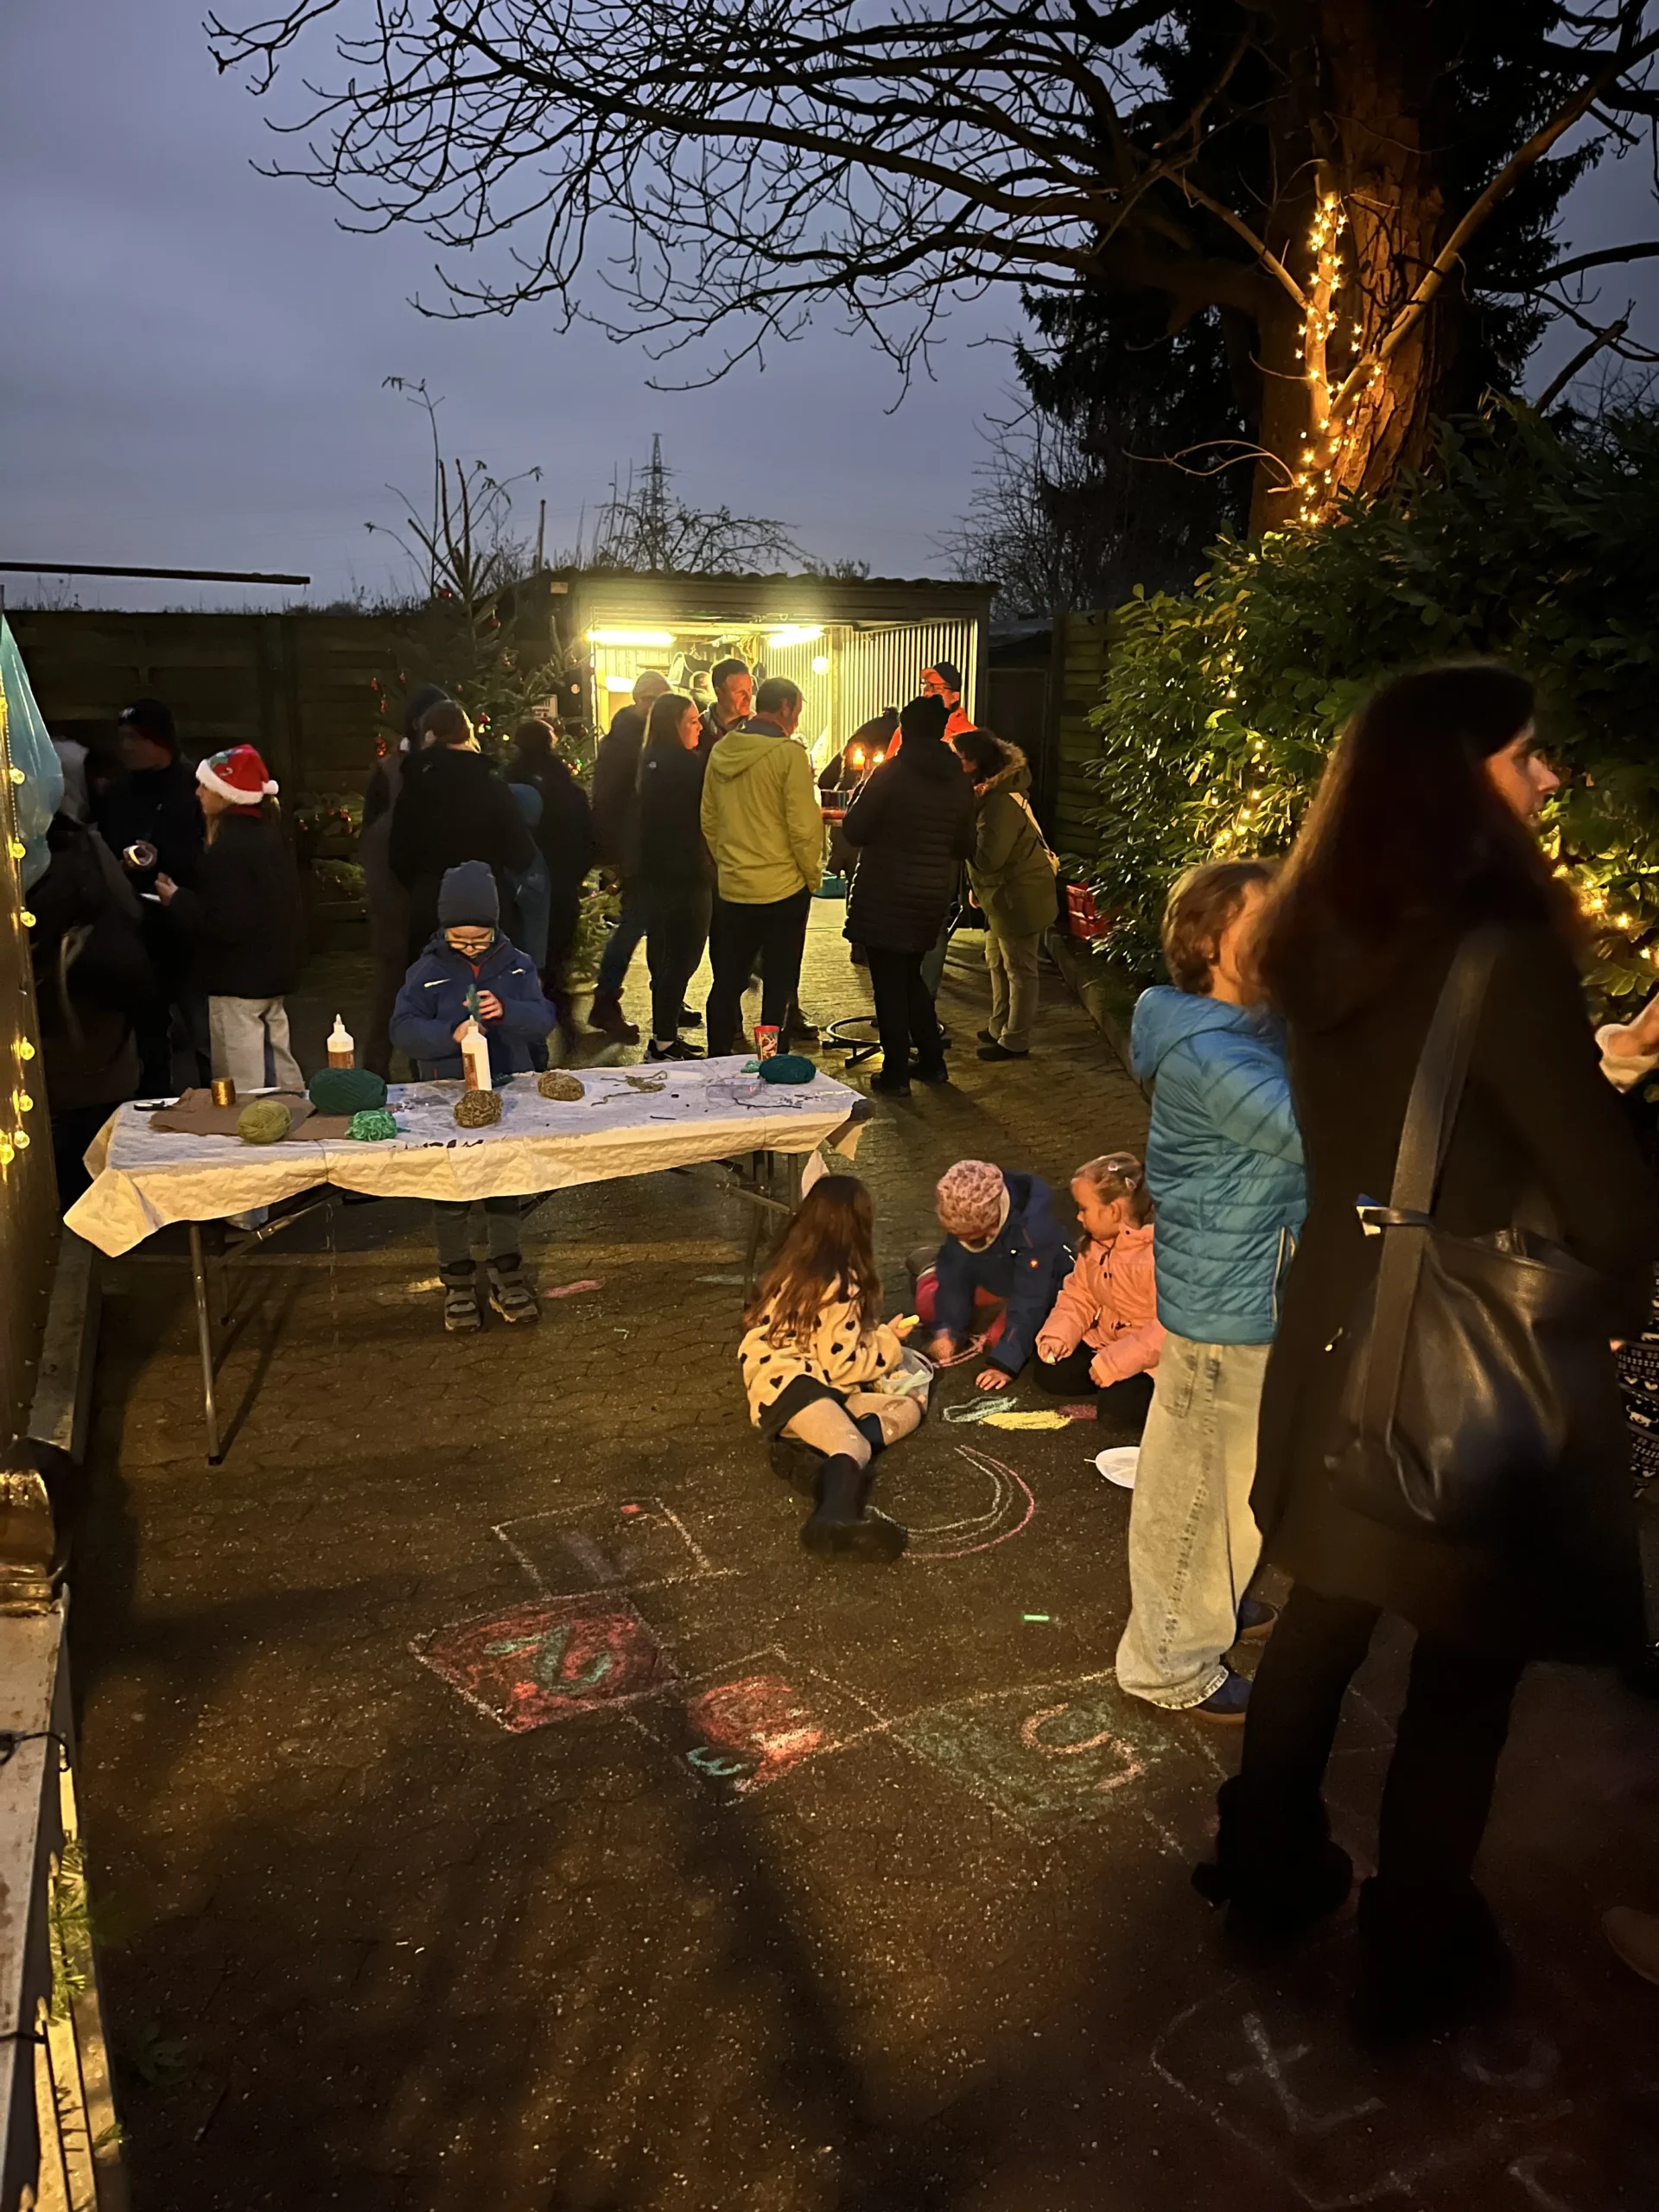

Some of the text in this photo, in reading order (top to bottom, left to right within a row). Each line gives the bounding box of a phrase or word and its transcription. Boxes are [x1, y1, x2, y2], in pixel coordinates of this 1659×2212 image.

[483, 1624, 612, 1695] 2
[685, 1745, 748, 1777] 3
[1020, 1701, 1149, 1793] 5
